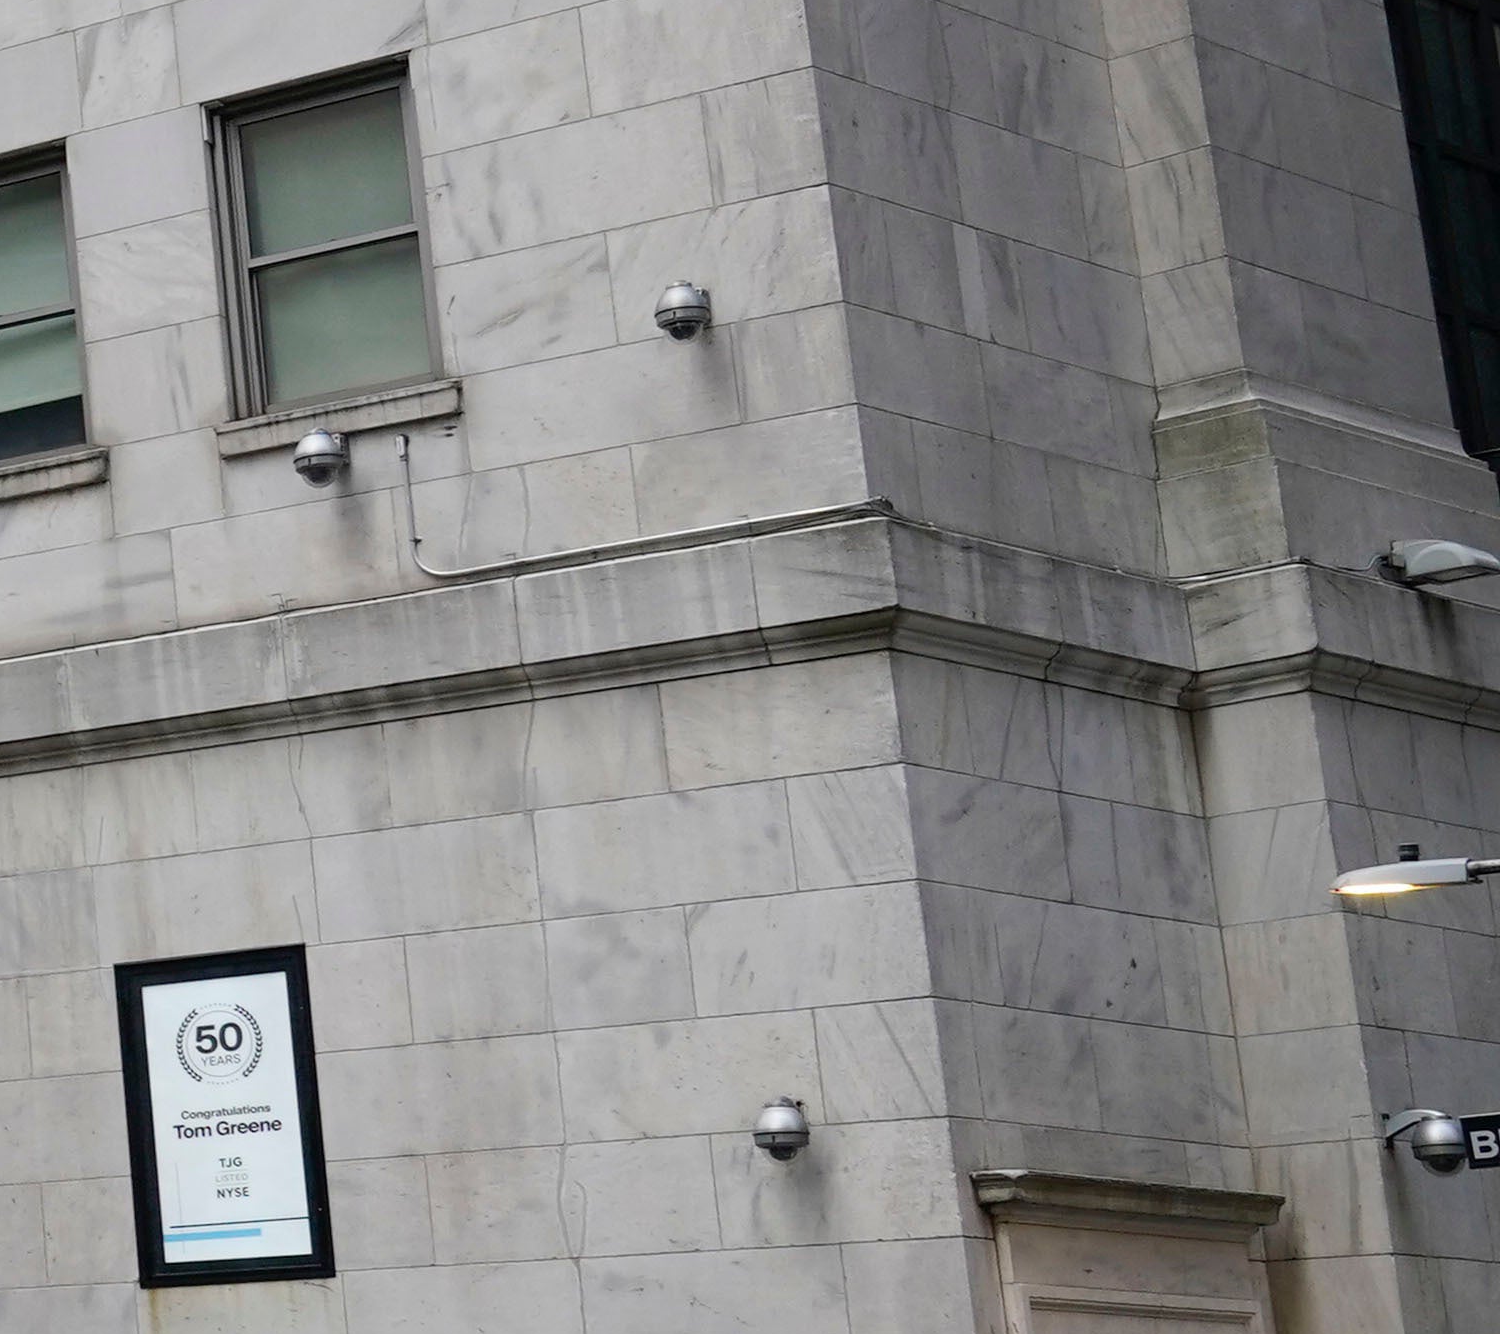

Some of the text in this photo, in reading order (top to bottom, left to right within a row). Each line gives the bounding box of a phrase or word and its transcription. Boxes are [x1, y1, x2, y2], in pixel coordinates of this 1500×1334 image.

[195, 1022, 243, 1054] 50
[200, 1053, 242, 1067] YEARS
[180, 1104, 272, 1121] Congratulations
[173, 1119, 283, 1140] Tom Greene
[1469, 1128, 1500, 1160] B
[218, 1156, 243, 1168] TJG
[214, 1173, 250, 1184] LISTED
[216, 1186, 250, 1199] NYSE
